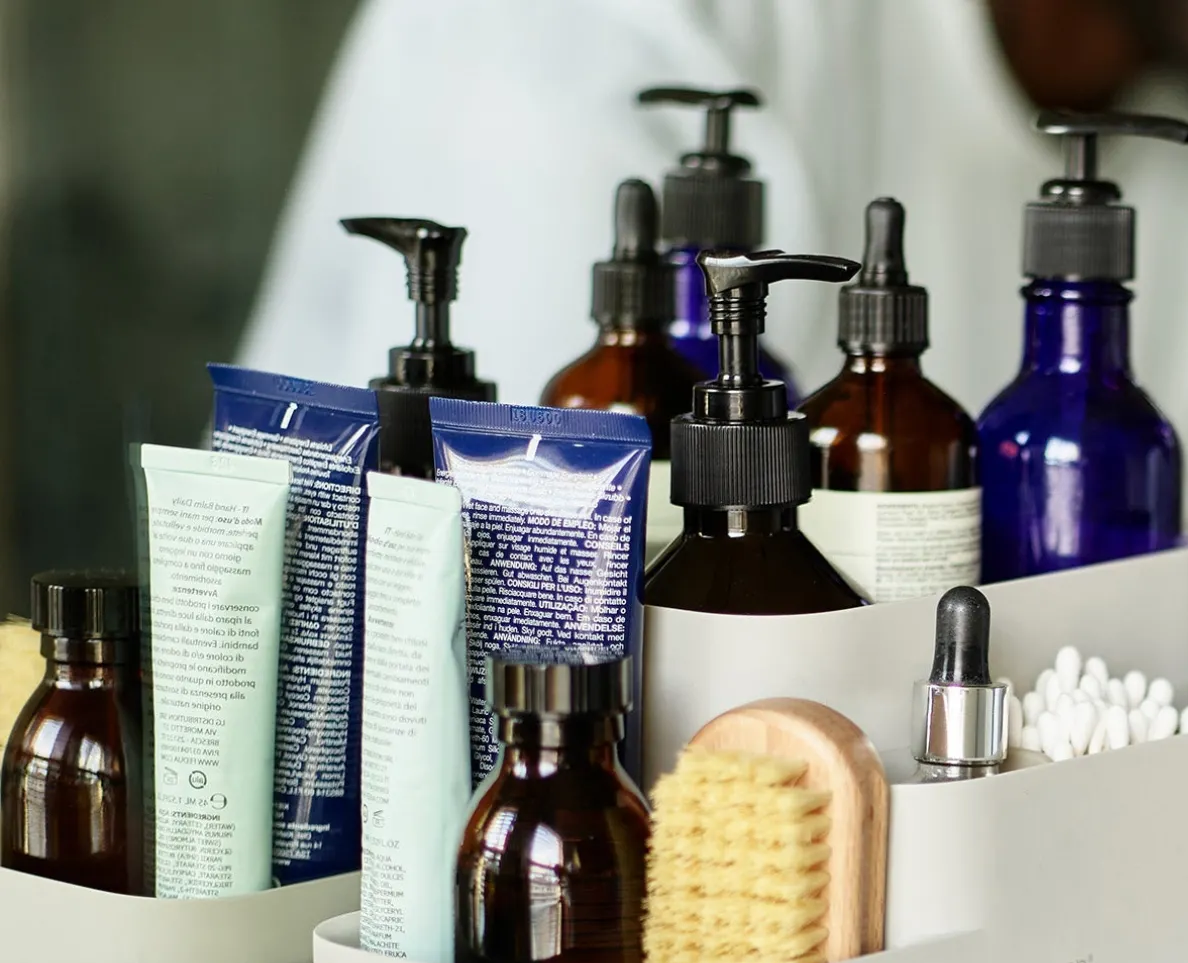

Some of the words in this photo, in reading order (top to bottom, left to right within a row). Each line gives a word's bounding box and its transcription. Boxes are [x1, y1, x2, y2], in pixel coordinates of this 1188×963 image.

[472, 511, 488, 521] rinse
[488, 512, 527, 526] immediately.
[527, 515, 551, 527] MODO
[551, 517, 563, 528] DE
[563, 518, 597, 532] EMPLEO:
[623, 515, 632, 524] of
[505, 523, 533, 536] Enjuagar
[498, 542, 508, 551] sur
[511, 543, 532, 554] visage
[533, 544, 558, 556] humide
[584, 539, 630, 552] CONSEILS
[509, 551, 534, 562] contact
[490, 558, 538, 572] ANWENDUNG:
[541, 563, 553, 573] Auf
[554, 564, 568, 574] das
[502, 568, 515, 579] Gut
[558, 574, 570, 584] Bei
[507, 578, 541, 590] CONSIGLI
[541, 582, 556, 592] PER
[556, 584, 583, 595] L'USO:
[498, 586, 538, 600] Risciacquare
[556, 593, 564, 602] In
[564, 594, 583, 604] caso
[564, 621, 626, 633] ANVENDELSE:
[556, 629, 572, 639] Ved
[574, 631, 605, 642] kontakt
[606, 633, 625, 642] med
